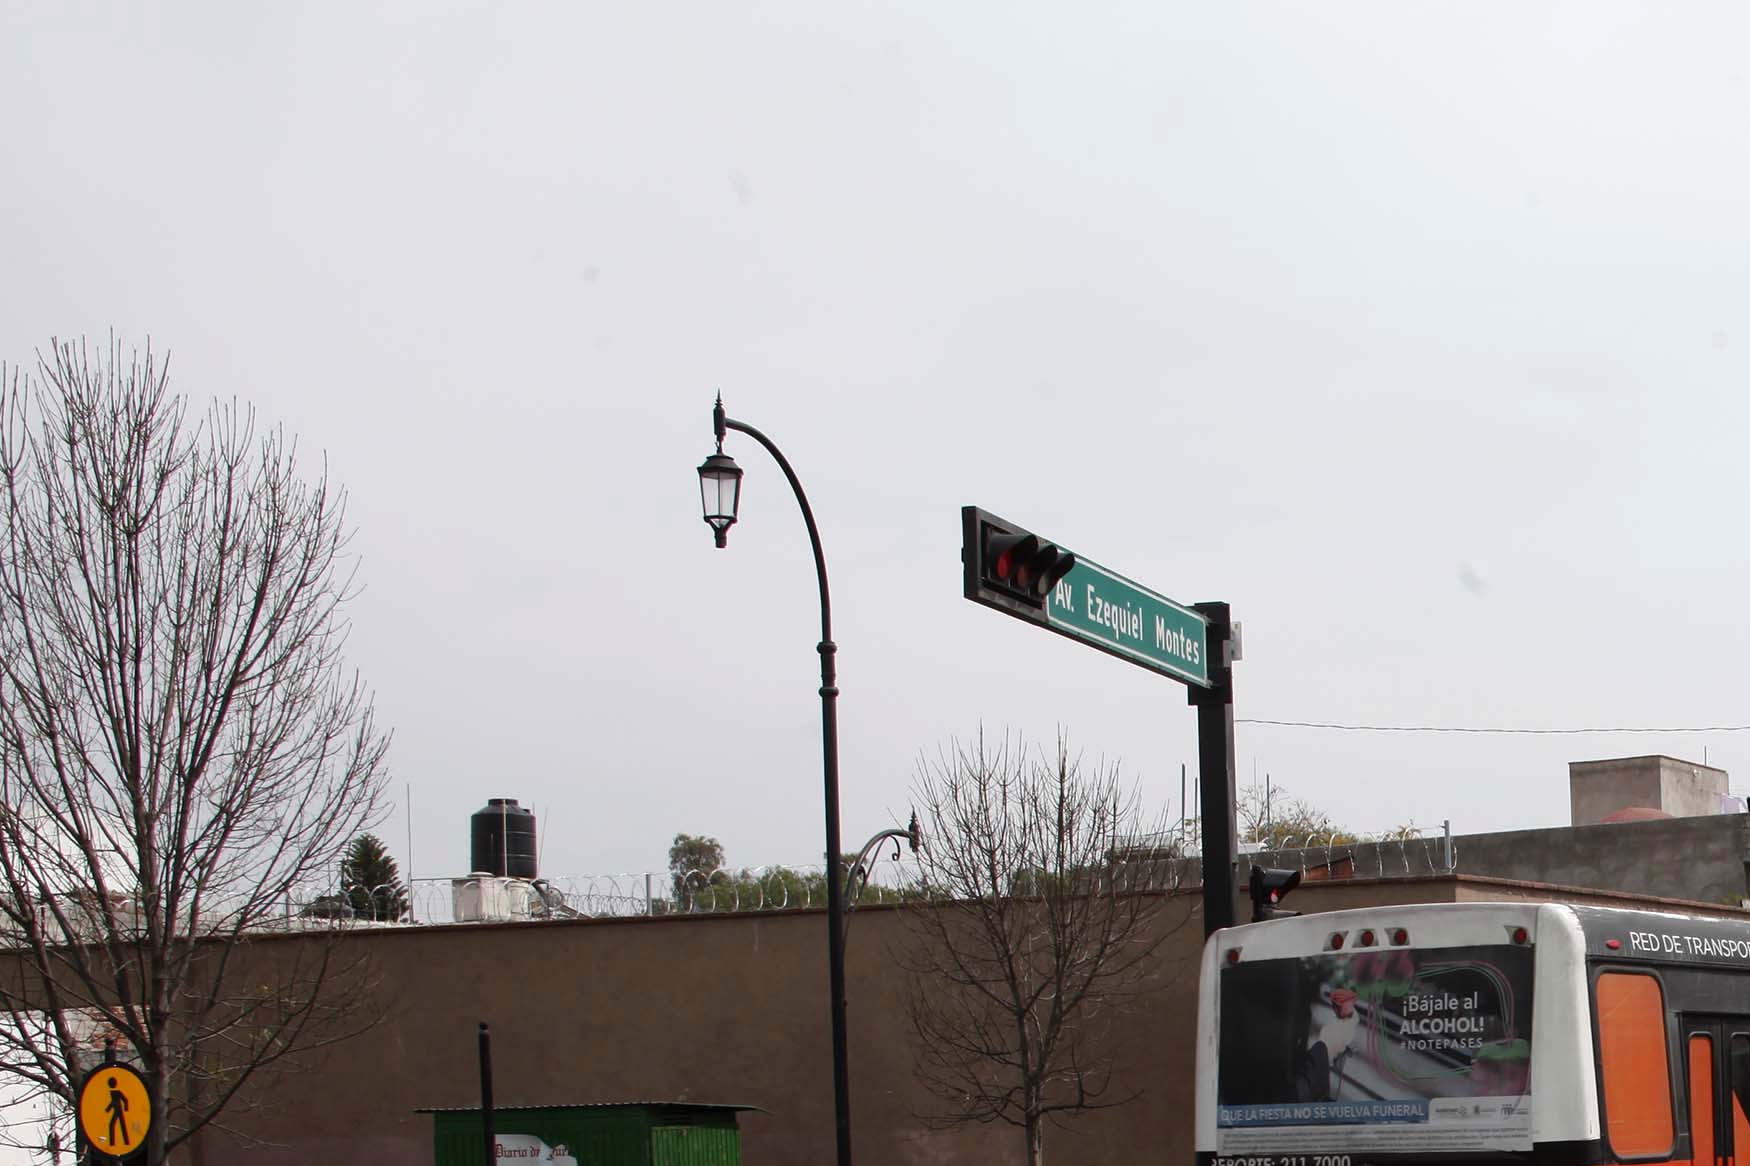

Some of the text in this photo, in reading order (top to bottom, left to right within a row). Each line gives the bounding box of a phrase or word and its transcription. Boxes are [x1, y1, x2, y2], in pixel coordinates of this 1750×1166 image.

[1055, 578, 1200, 665] Av. Ezequiel Montes
[1629, 931, 1660, 952] RED
[1661, 934, 1684, 954] DE
[1402, 991, 1478, 1017] ¡Bájale al
[1400, 1016, 1485, 1035] ALCOHOL!
[1400, 1037, 1484, 1051] #NOTEPASES
[1221, 1109, 1244, 1122] QUE
[1245, 1108, 1258, 1121] LA
[1259, 1108, 1292, 1120] FIESTA
[1294, 1107, 1311, 1120] NO
[1314, 1106, 1327, 1119] SE
[1328, 1105, 1371, 1118] VUELVA
[1372, 1103, 1425, 1118] FUNERAL
